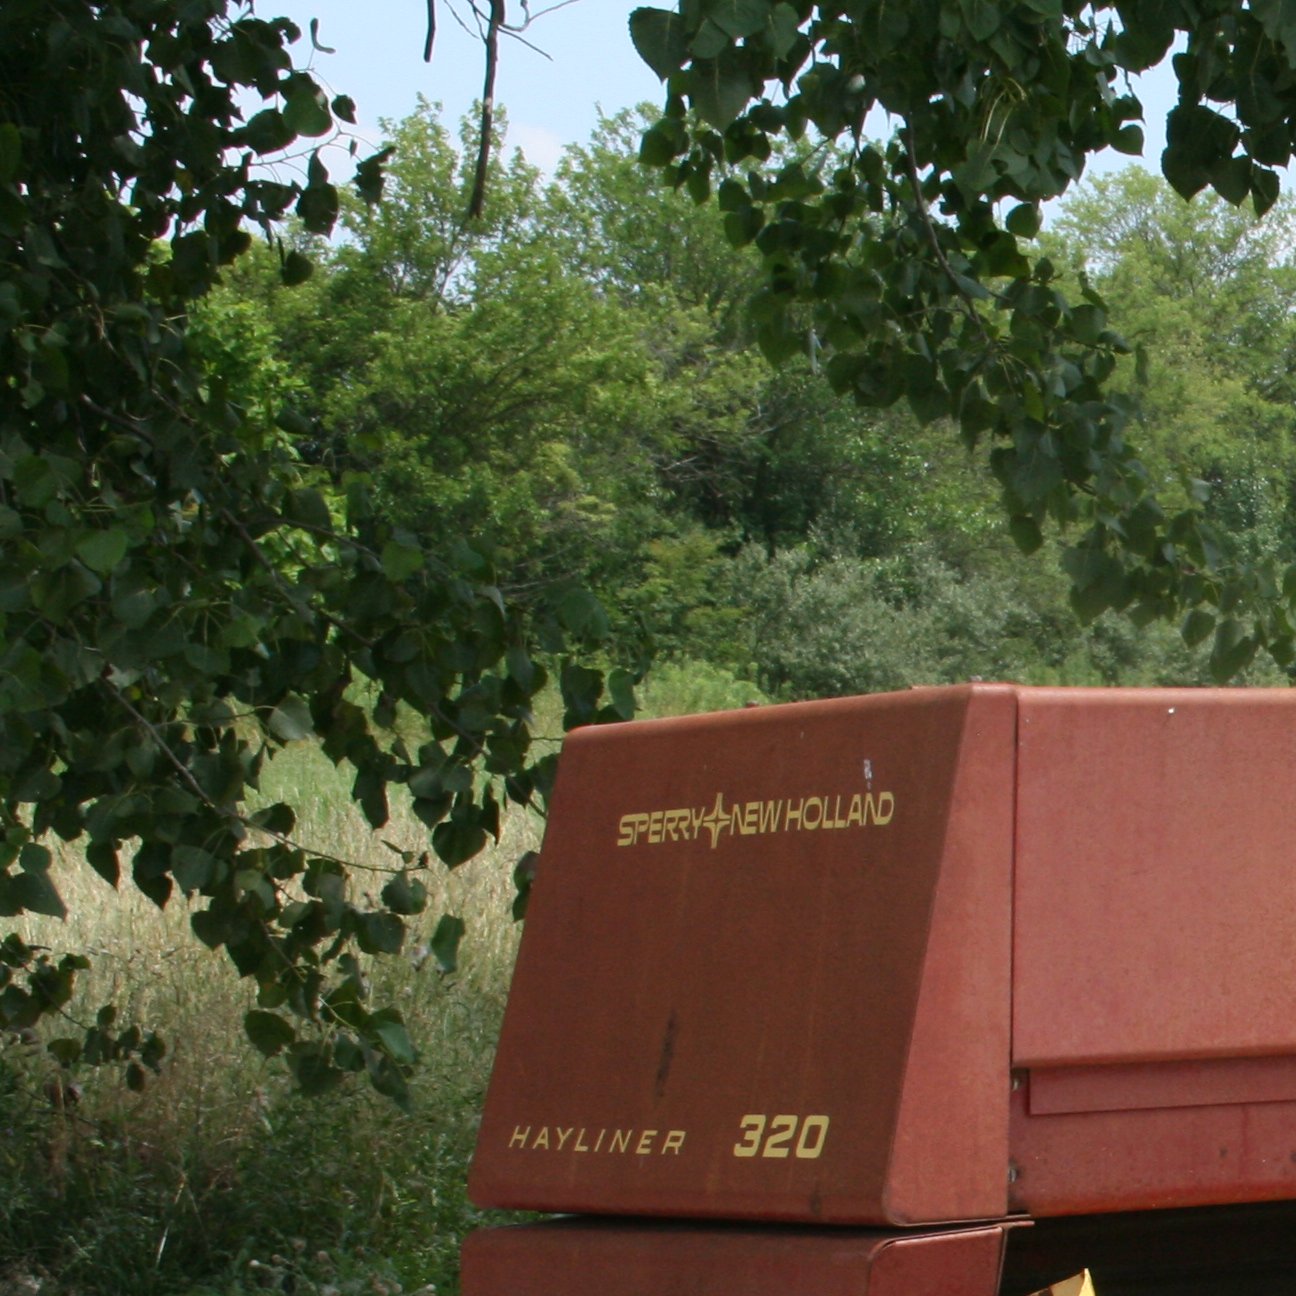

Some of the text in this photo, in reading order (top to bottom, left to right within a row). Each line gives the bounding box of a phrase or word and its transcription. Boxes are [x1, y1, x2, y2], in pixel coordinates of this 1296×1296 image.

[616, 791, 895, 847] SPERRY NEW HOLLAND
[508, 1114, 830, 1159] HAYLINER 320
